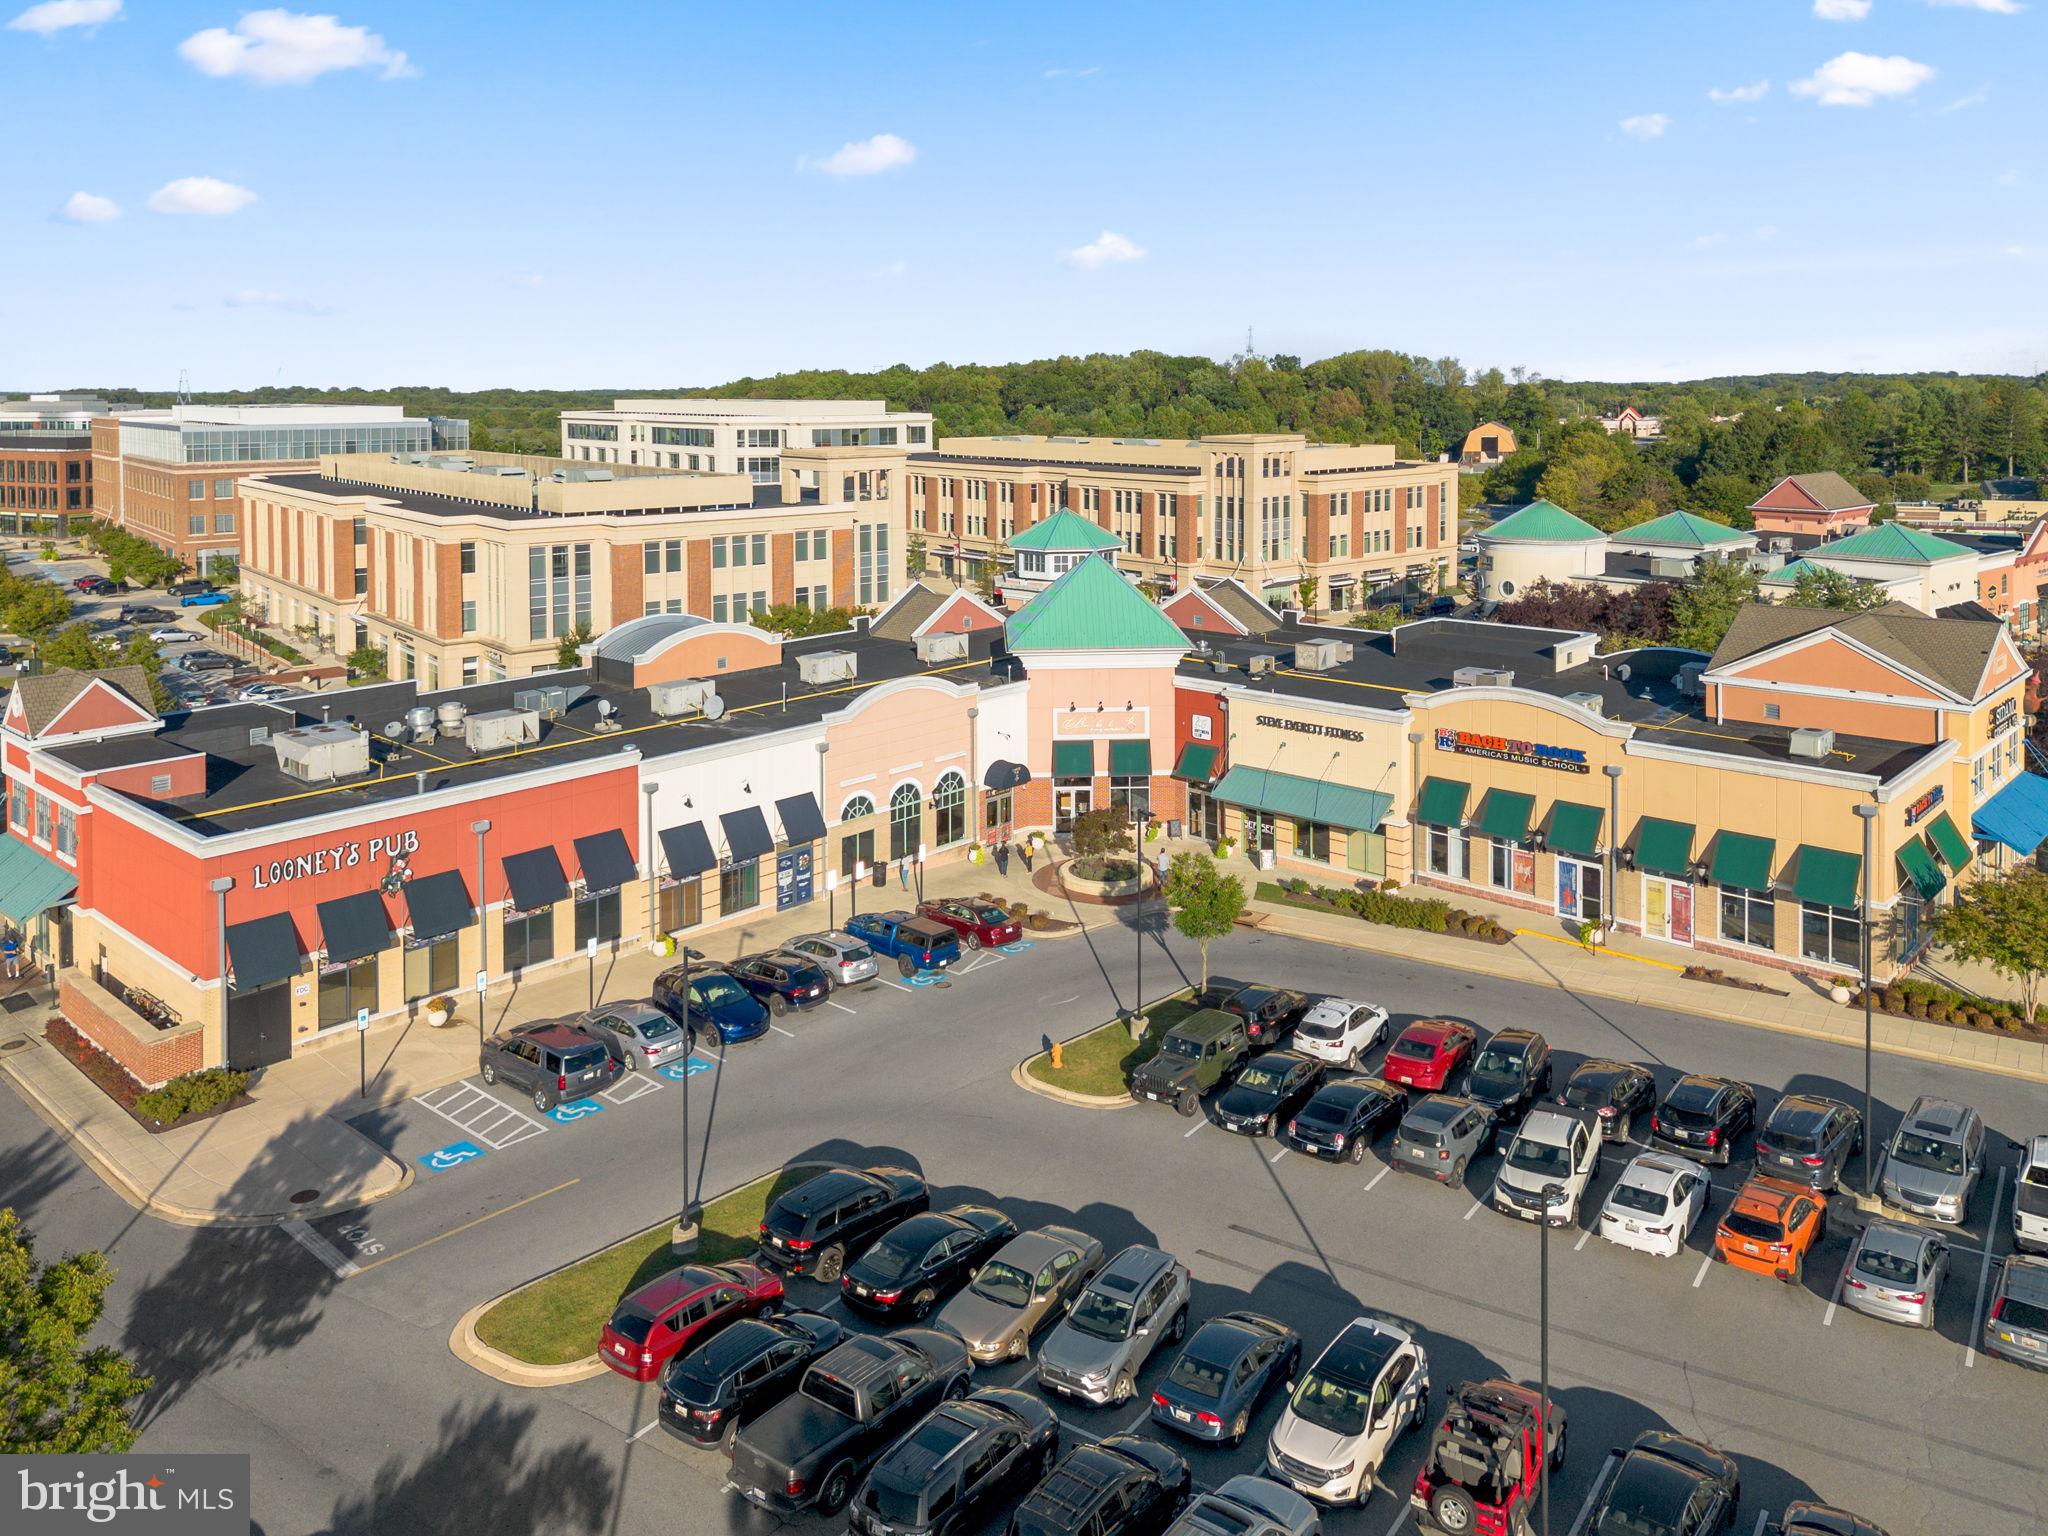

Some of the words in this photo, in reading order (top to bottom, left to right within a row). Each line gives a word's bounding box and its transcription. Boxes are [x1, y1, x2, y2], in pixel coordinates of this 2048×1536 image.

[1256, 715, 1284, 729] STEVE
[1284, 719, 1323, 736] EVERETT
[1324, 726, 1364, 742] FITNESS
[1457, 731, 1507, 750] BACH
[1508, 739, 1533, 754] TO
[1534, 743, 1587, 763] ROCK
[1465, 746, 1508, 760] AMERICA'S
[1511, 754, 1539, 765] MUSIC
[1541, 759, 1580, 772] SCHOOL
[253, 842, 361, 889] LOONEY'S
[368, 830, 420, 862] PUB
[296, 985, 309, 994] FDC
[337, 1225, 386, 1256] STOP
